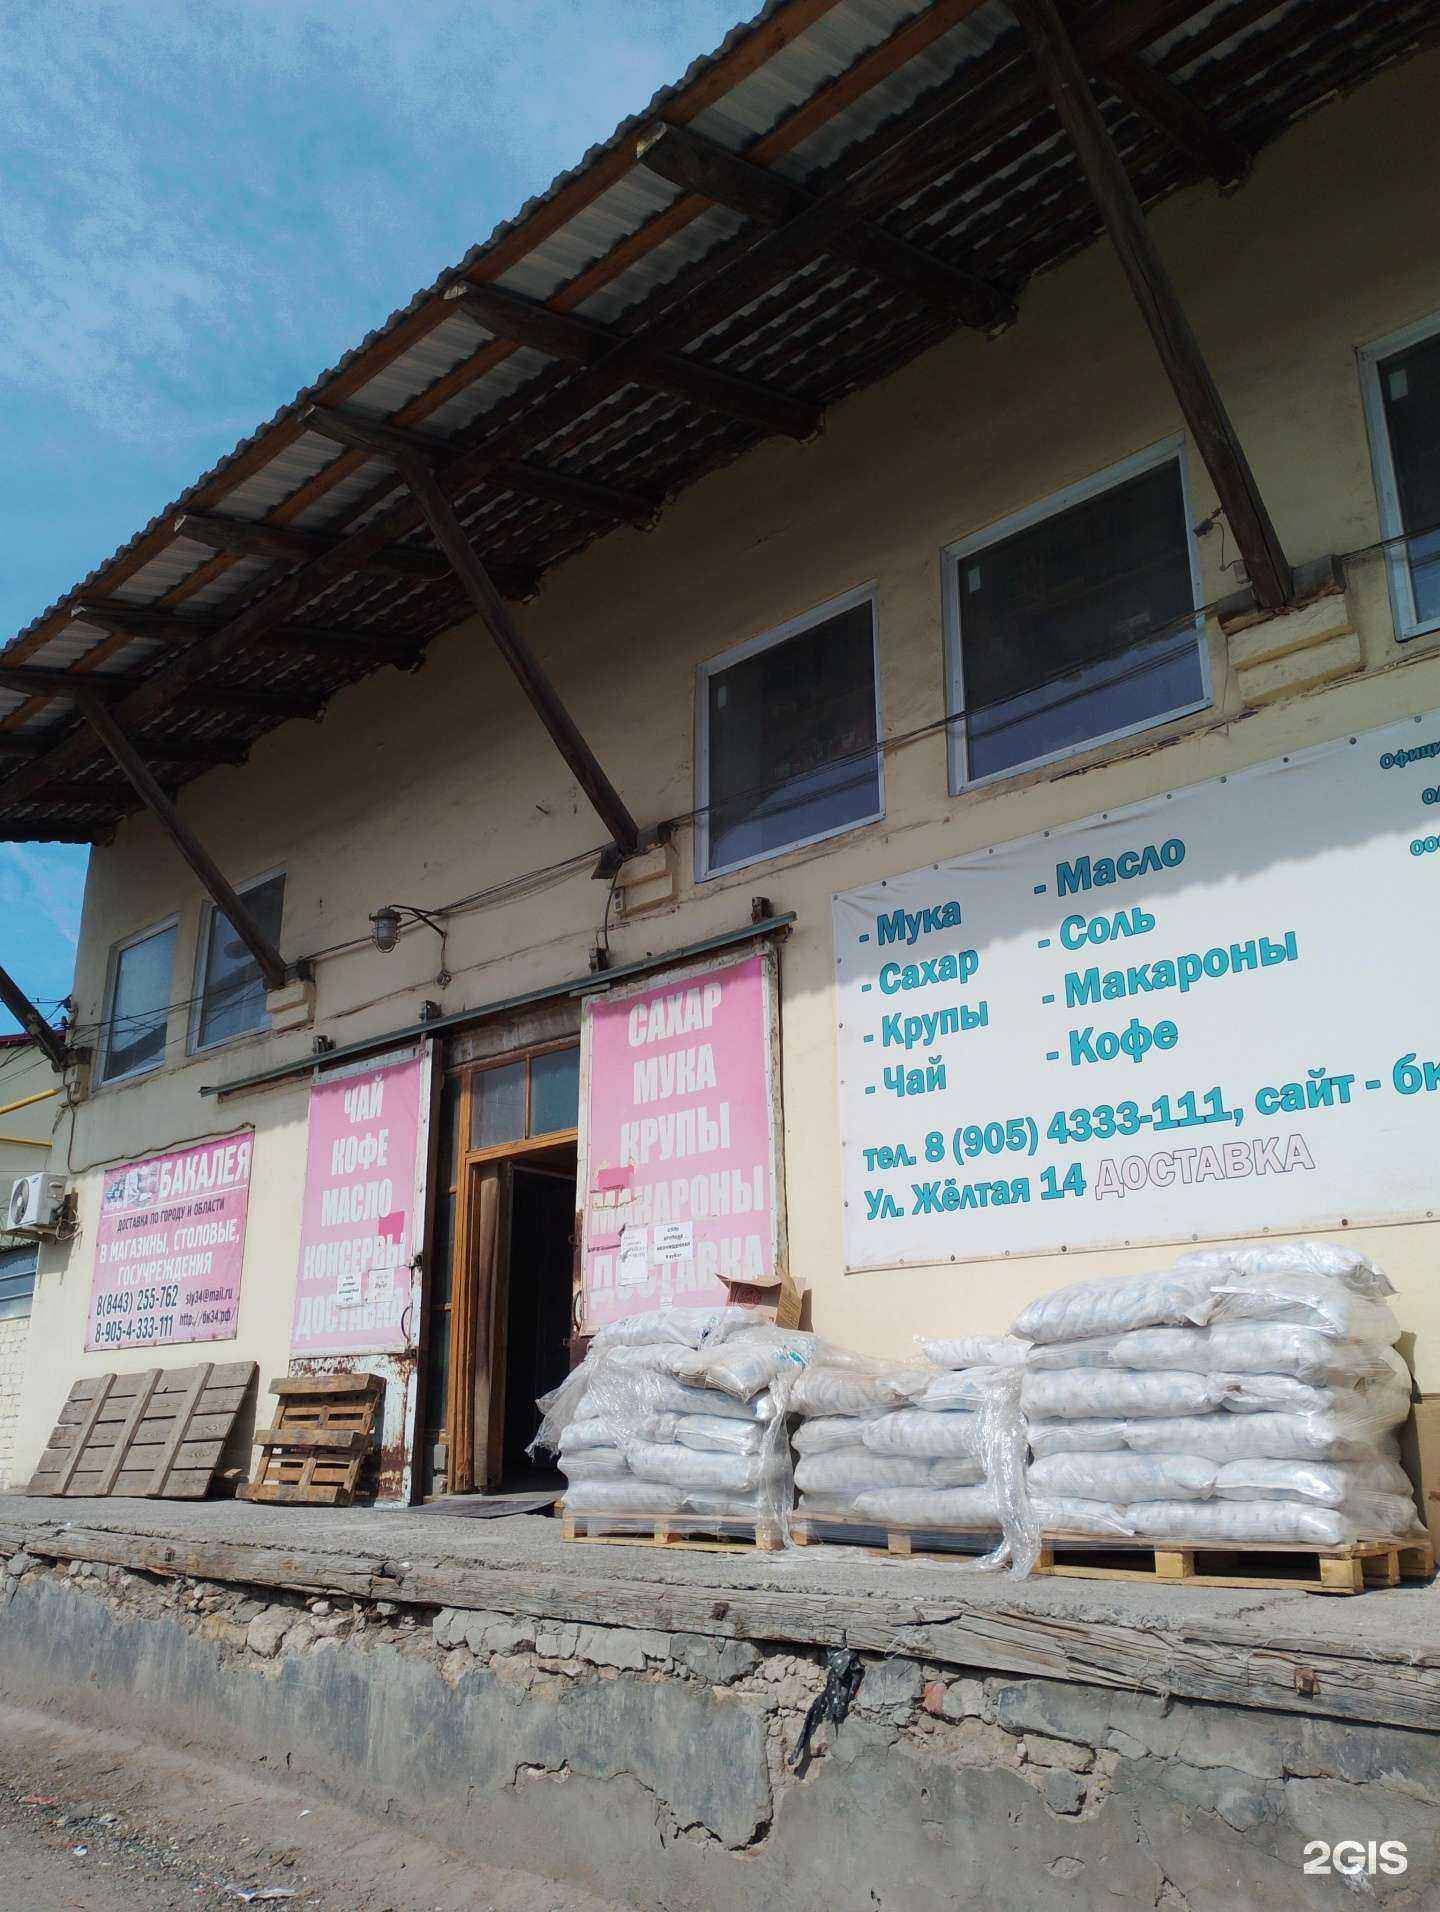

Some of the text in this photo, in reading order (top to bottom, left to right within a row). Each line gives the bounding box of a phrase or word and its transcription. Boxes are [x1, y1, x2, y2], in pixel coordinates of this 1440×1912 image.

[1055, 838, 1186, 897] Масло
[876, 901, 962, 946] Мука
[1059, 907, 1156, 950] Соль
[879, 949, 979, 995] Сахар
[1064, 931, 1299, 1008] Макароны
[628, 982, 722, 1047] САХАР
[881, 1001, 989, 1050] Крупы
[1068, 1018, 1179, 1066] Кофе
[344, 1073, 385, 1123] ЧАЙ
[633, 1044, 717, 1104] МУКА
[883, 1054, 947, 1097] Чай
[620, 1102, 731, 1167] КРУПЫ
[863, 1144, 917, 1172] тел.
[924, 1131, 946, 1162] 8
[953, 1117, 1039, 1165] (905)
[1047, 1086, 1244, 1144] 4333-111,
[1255, 1067, 1355, 1115] сайт
[158, 1141, 250, 1198] БАКАЛЕЯ
[331, 1129, 389, 1175] КОФЕ
[591, 1165, 764, 1235] МАКАРОНЫ
[864, 1133, 1316, 1220] Ул. Жёлтая 14 ДОСТАВКА
[117, 1198, 225, 1232] ДОСТАВКА ПО ГОРОДУ И ОБЛАСТИ
[321, 1178, 392, 1226] МАСЛО
[100, 1219, 240, 1264] В МАГАЗИНЫ, СТОЛОВЫЕ,
[303, 1232, 407, 1280] КОНСЕРВЫ
[118, 1252, 213, 1286] ГОСУЧРЕЖДЕНИЯ
[590, 1235, 766, 1309] ДТАВКА
[137, 1284, 179, 1311] 255-762
[95, 1315, 174, 1343] 8-905-4-333-111
